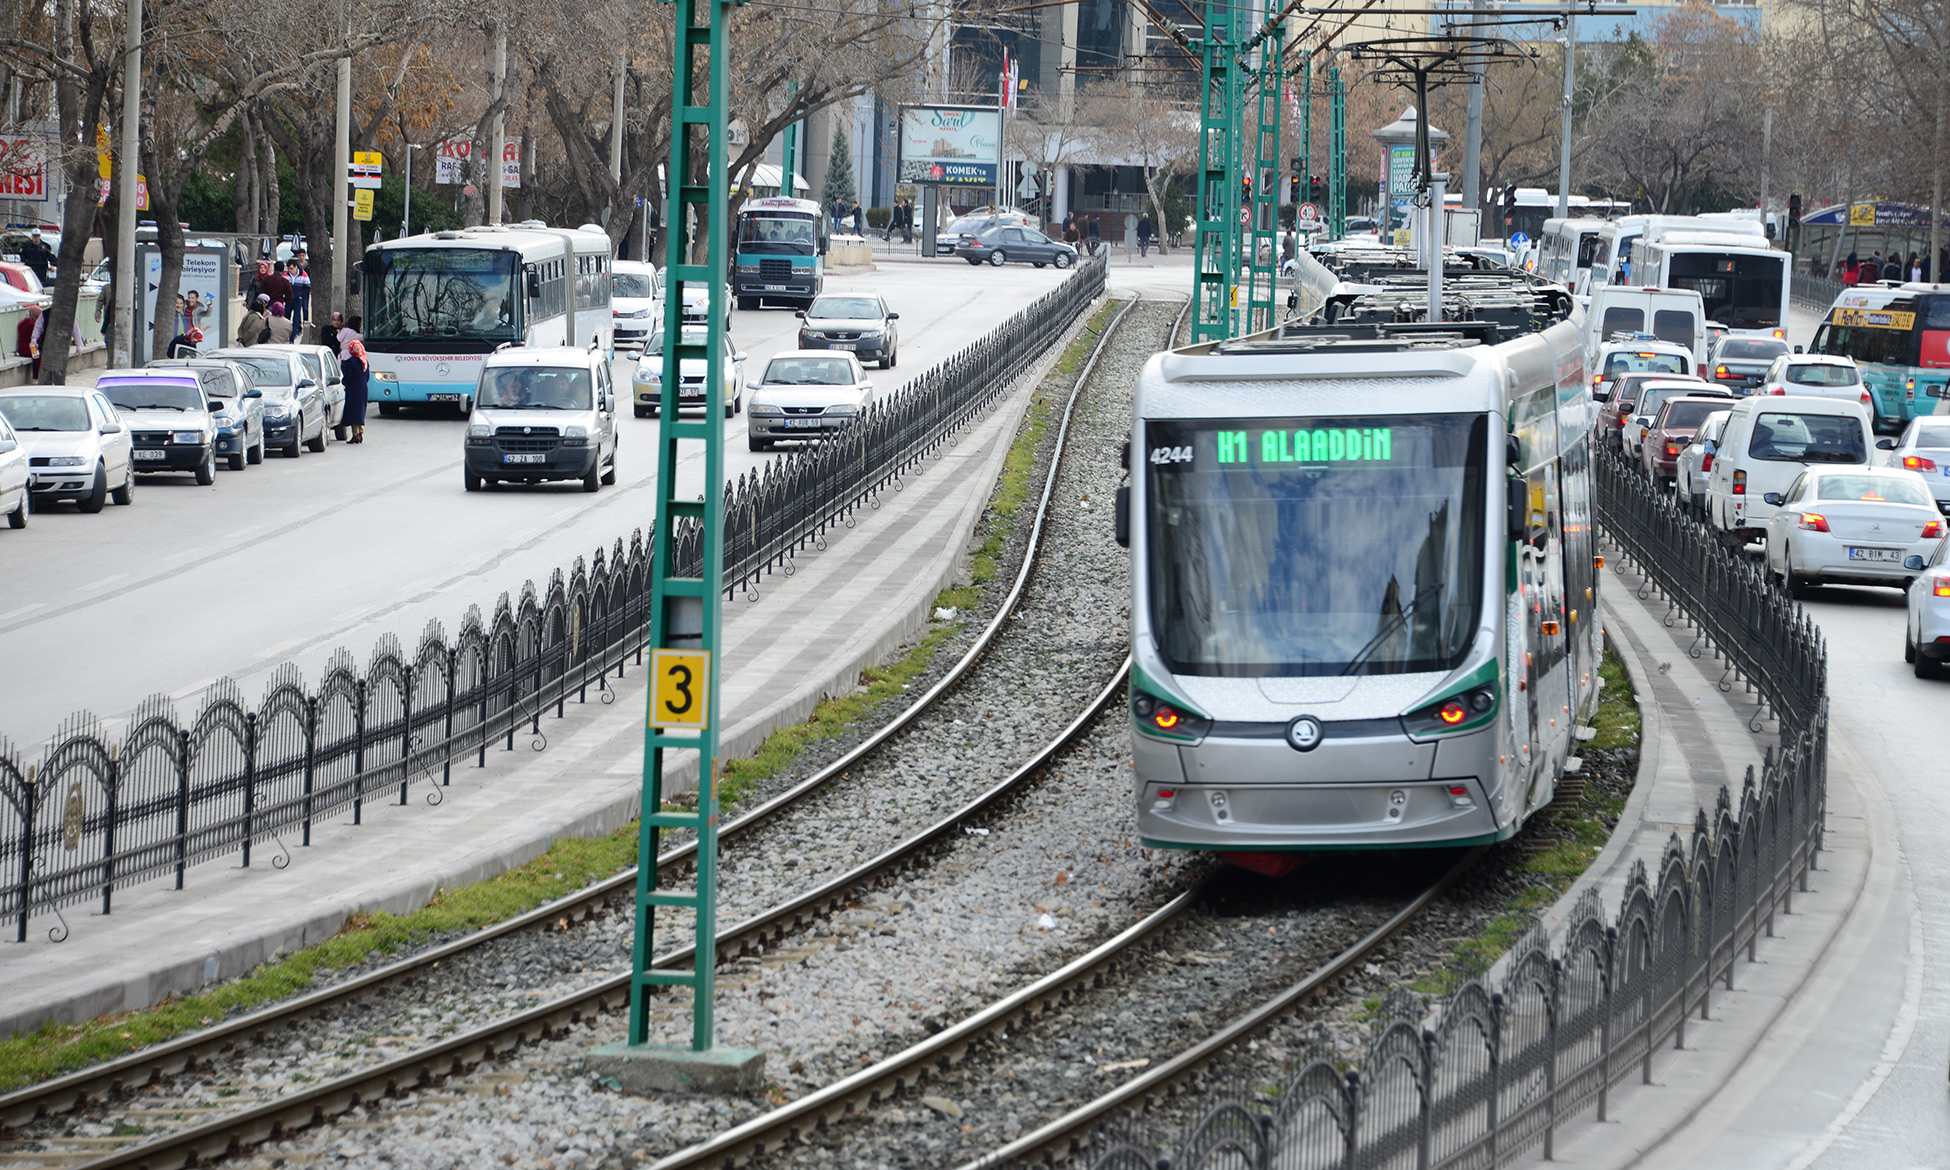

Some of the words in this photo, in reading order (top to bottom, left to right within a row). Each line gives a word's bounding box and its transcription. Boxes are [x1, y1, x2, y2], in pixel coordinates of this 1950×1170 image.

[186, 258, 217, 266] Telekom
[1150, 445, 1193, 464] 4244
[1217, 431, 1248, 463] H1
[664, 664, 693, 715] 3
